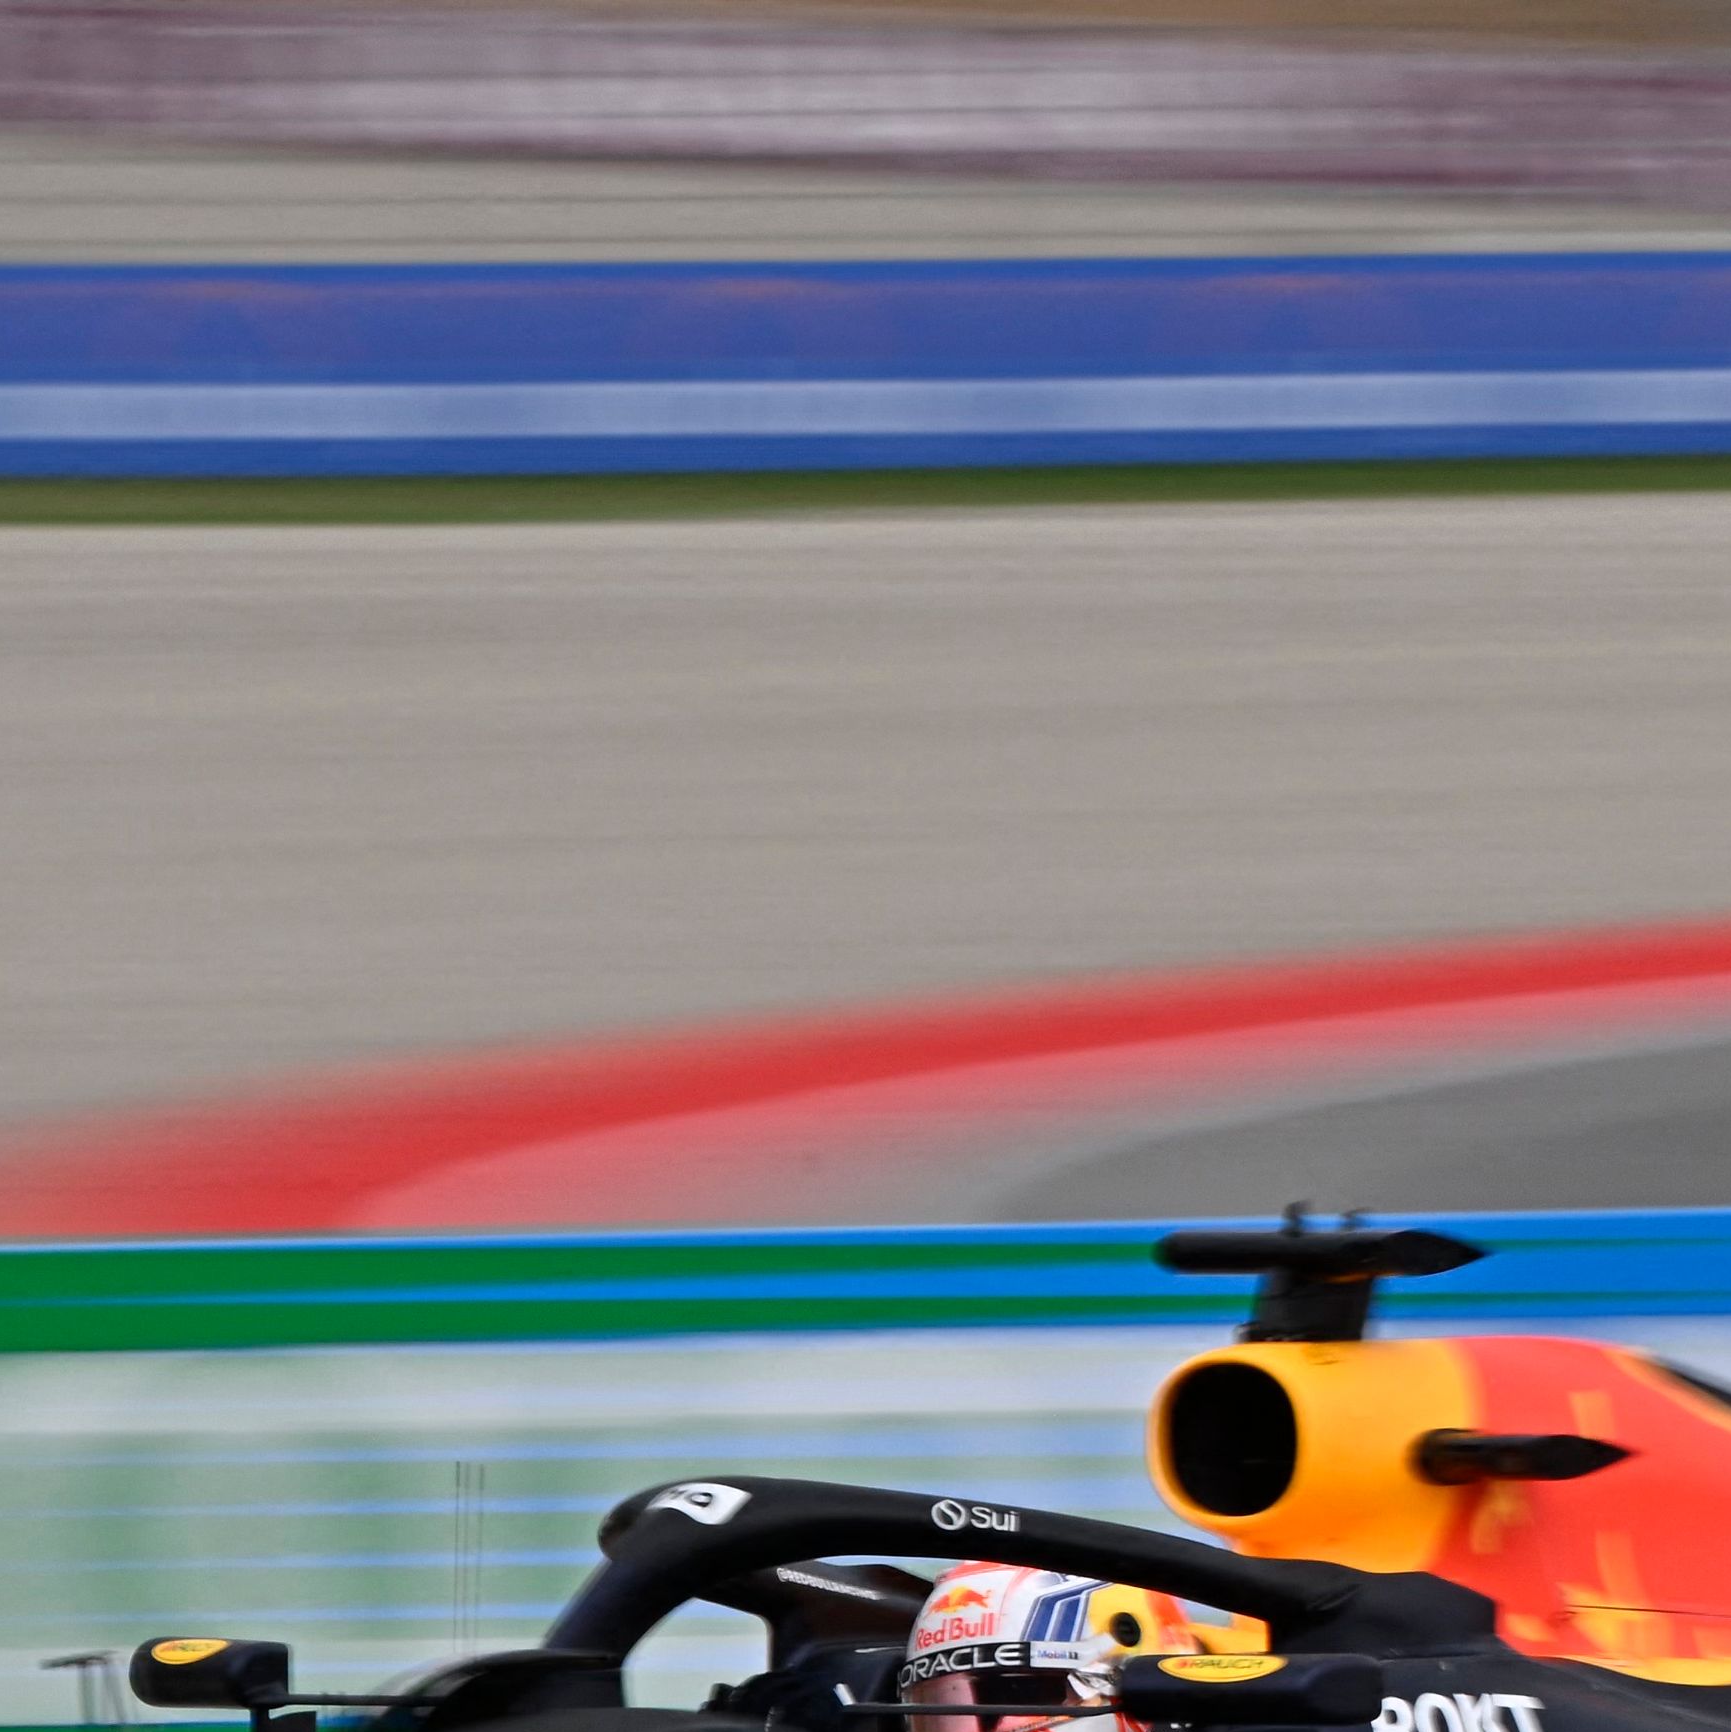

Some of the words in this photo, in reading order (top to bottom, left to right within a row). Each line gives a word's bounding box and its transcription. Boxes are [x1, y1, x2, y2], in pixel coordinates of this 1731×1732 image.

[970, 1506, 1020, 1532] Sui
[916, 1618, 946, 1650] Red
[948, 1612, 994, 1641] Bull
[899, 1643, 1023, 1689] ORACLE
[1189, 1657, 1263, 1669] RAUCH
